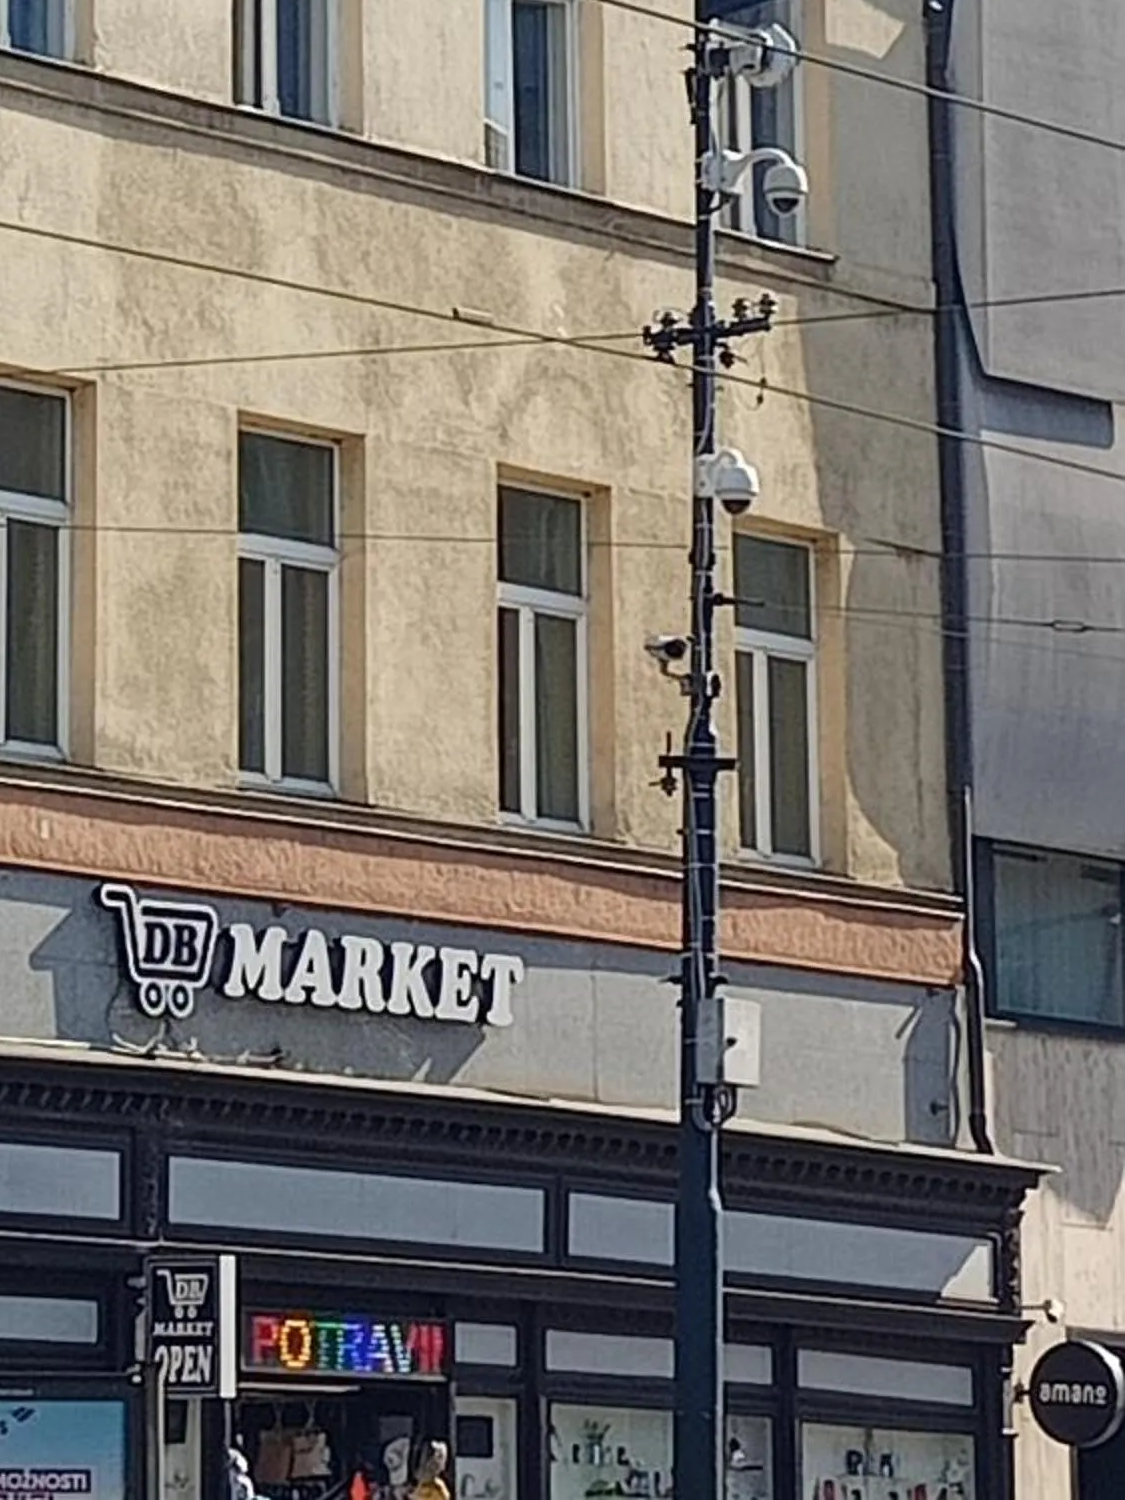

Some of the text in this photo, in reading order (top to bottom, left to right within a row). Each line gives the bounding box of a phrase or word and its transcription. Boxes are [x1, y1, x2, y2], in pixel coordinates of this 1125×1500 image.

[143, 921, 526, 1028] DB MARKET
[153, 1321, 214, 1337] MARKET
